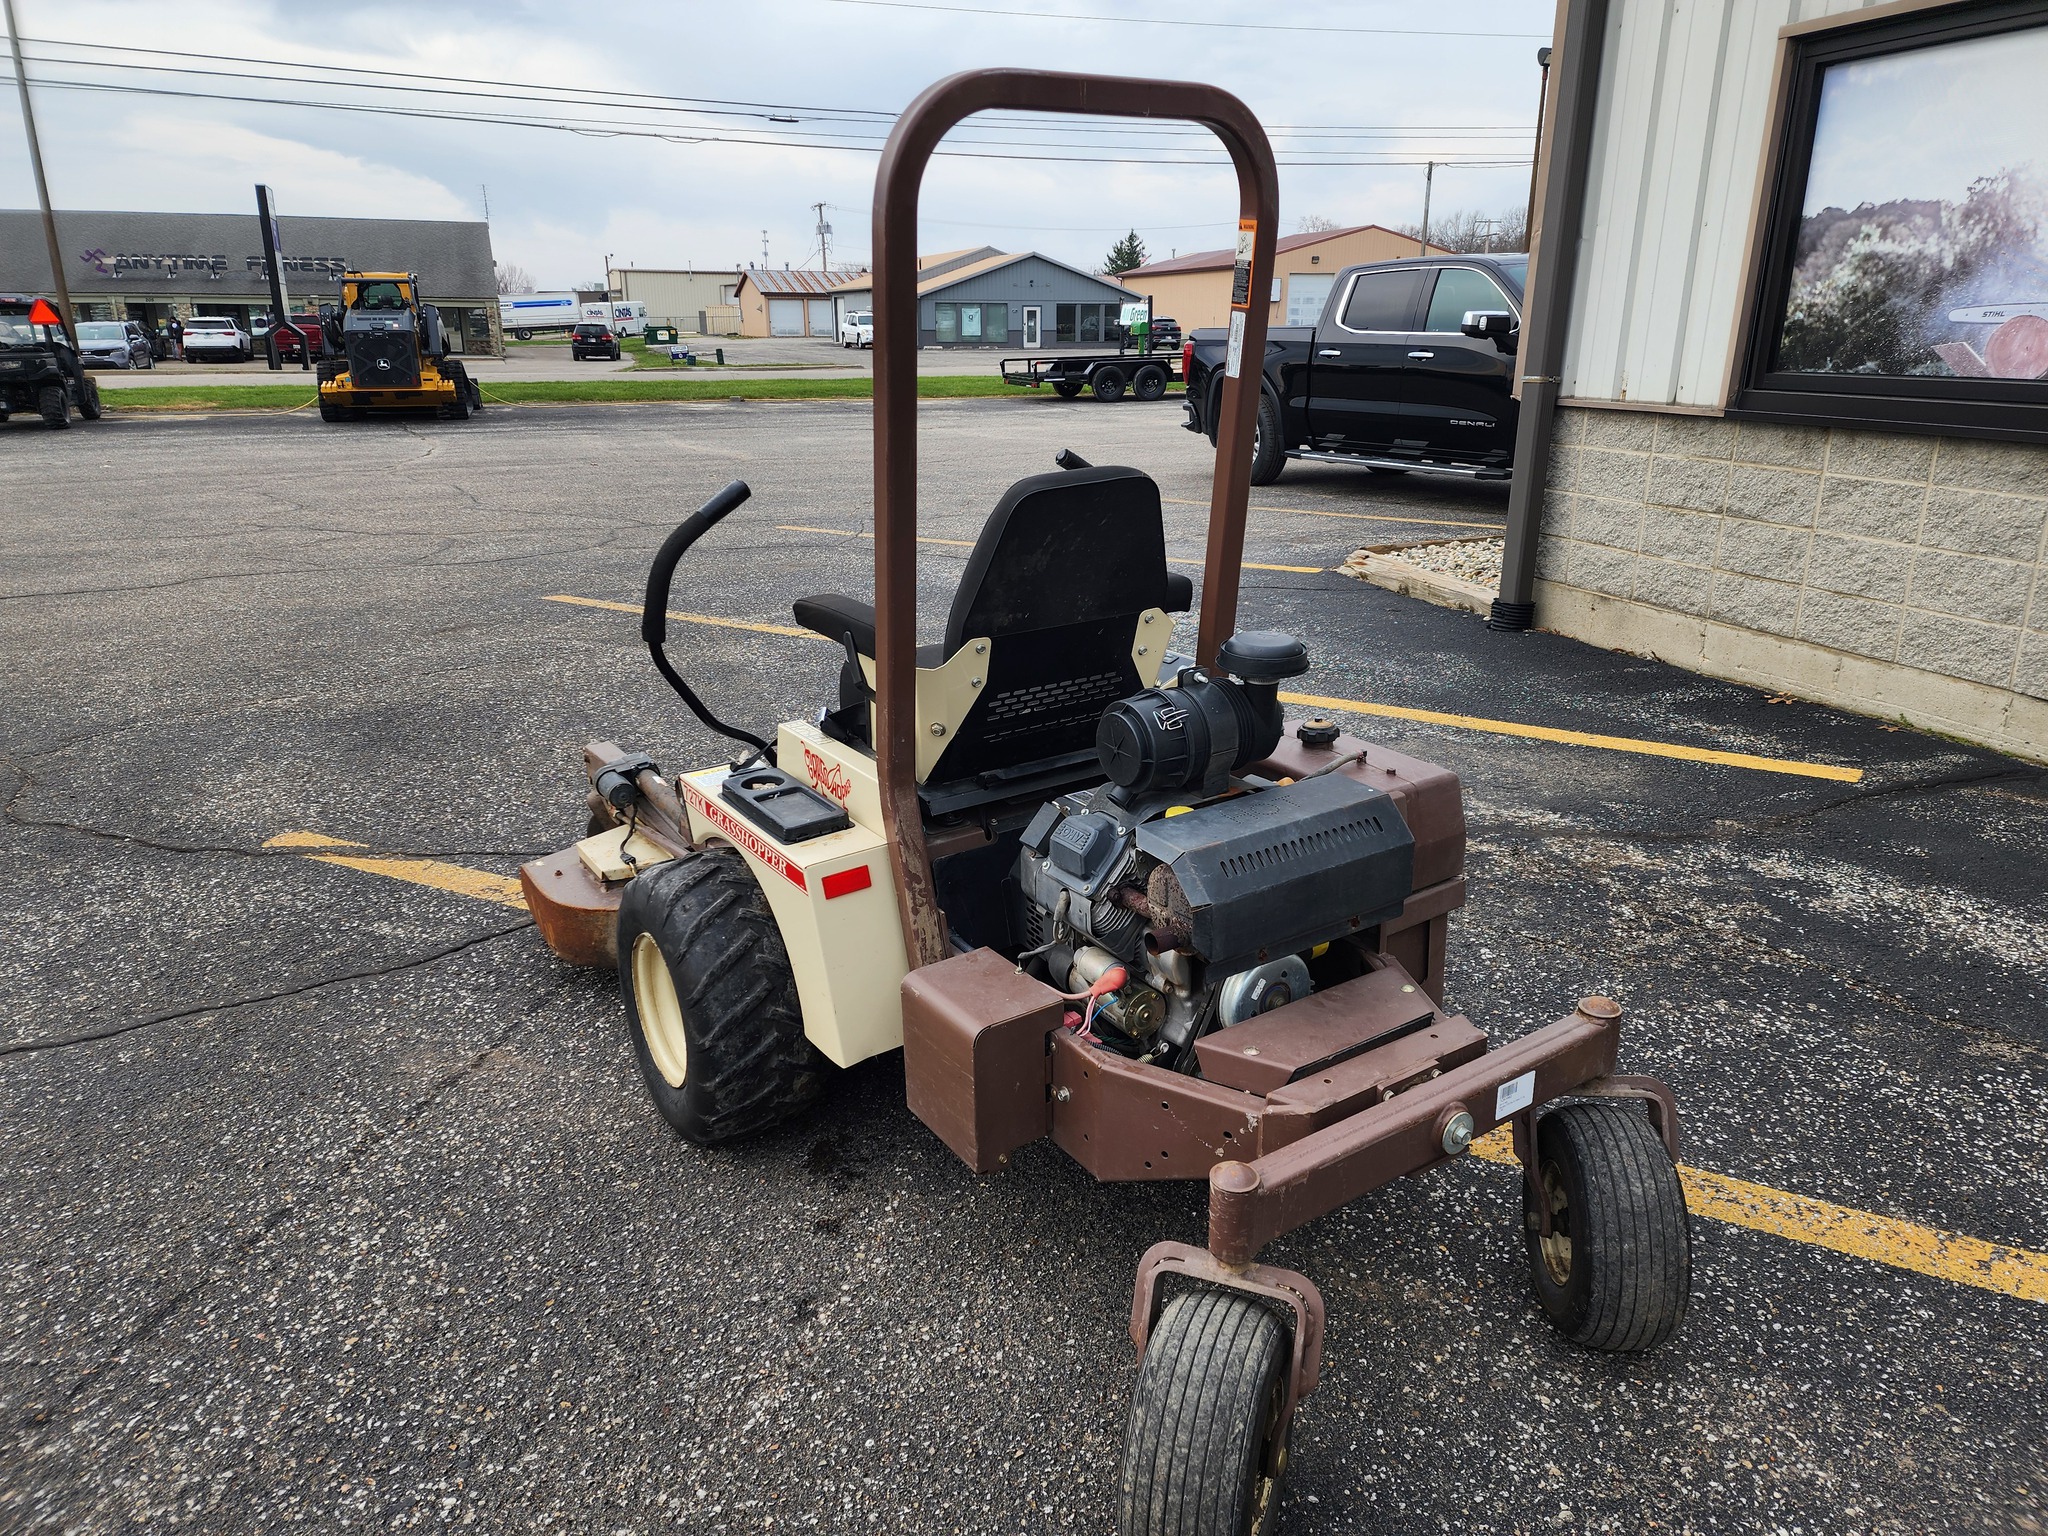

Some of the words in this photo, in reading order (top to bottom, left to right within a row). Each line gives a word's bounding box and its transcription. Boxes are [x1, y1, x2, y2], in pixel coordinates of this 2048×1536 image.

[114, 253, 228, 271] ANYTIME
[246, 256, 347, 273] FINESS
[586, 308, 603, 316] CINTAS
[614, 306, 632, 317] CINTAS
[1130, 307, 1148, 321] Green
[1450, 419, 1496, 428] DENALI
[683, 784, 706, 815] 727K
[709, 806, 788, 876] GRASSHOPPER
[1062, 826, 1085, 843] OHV
